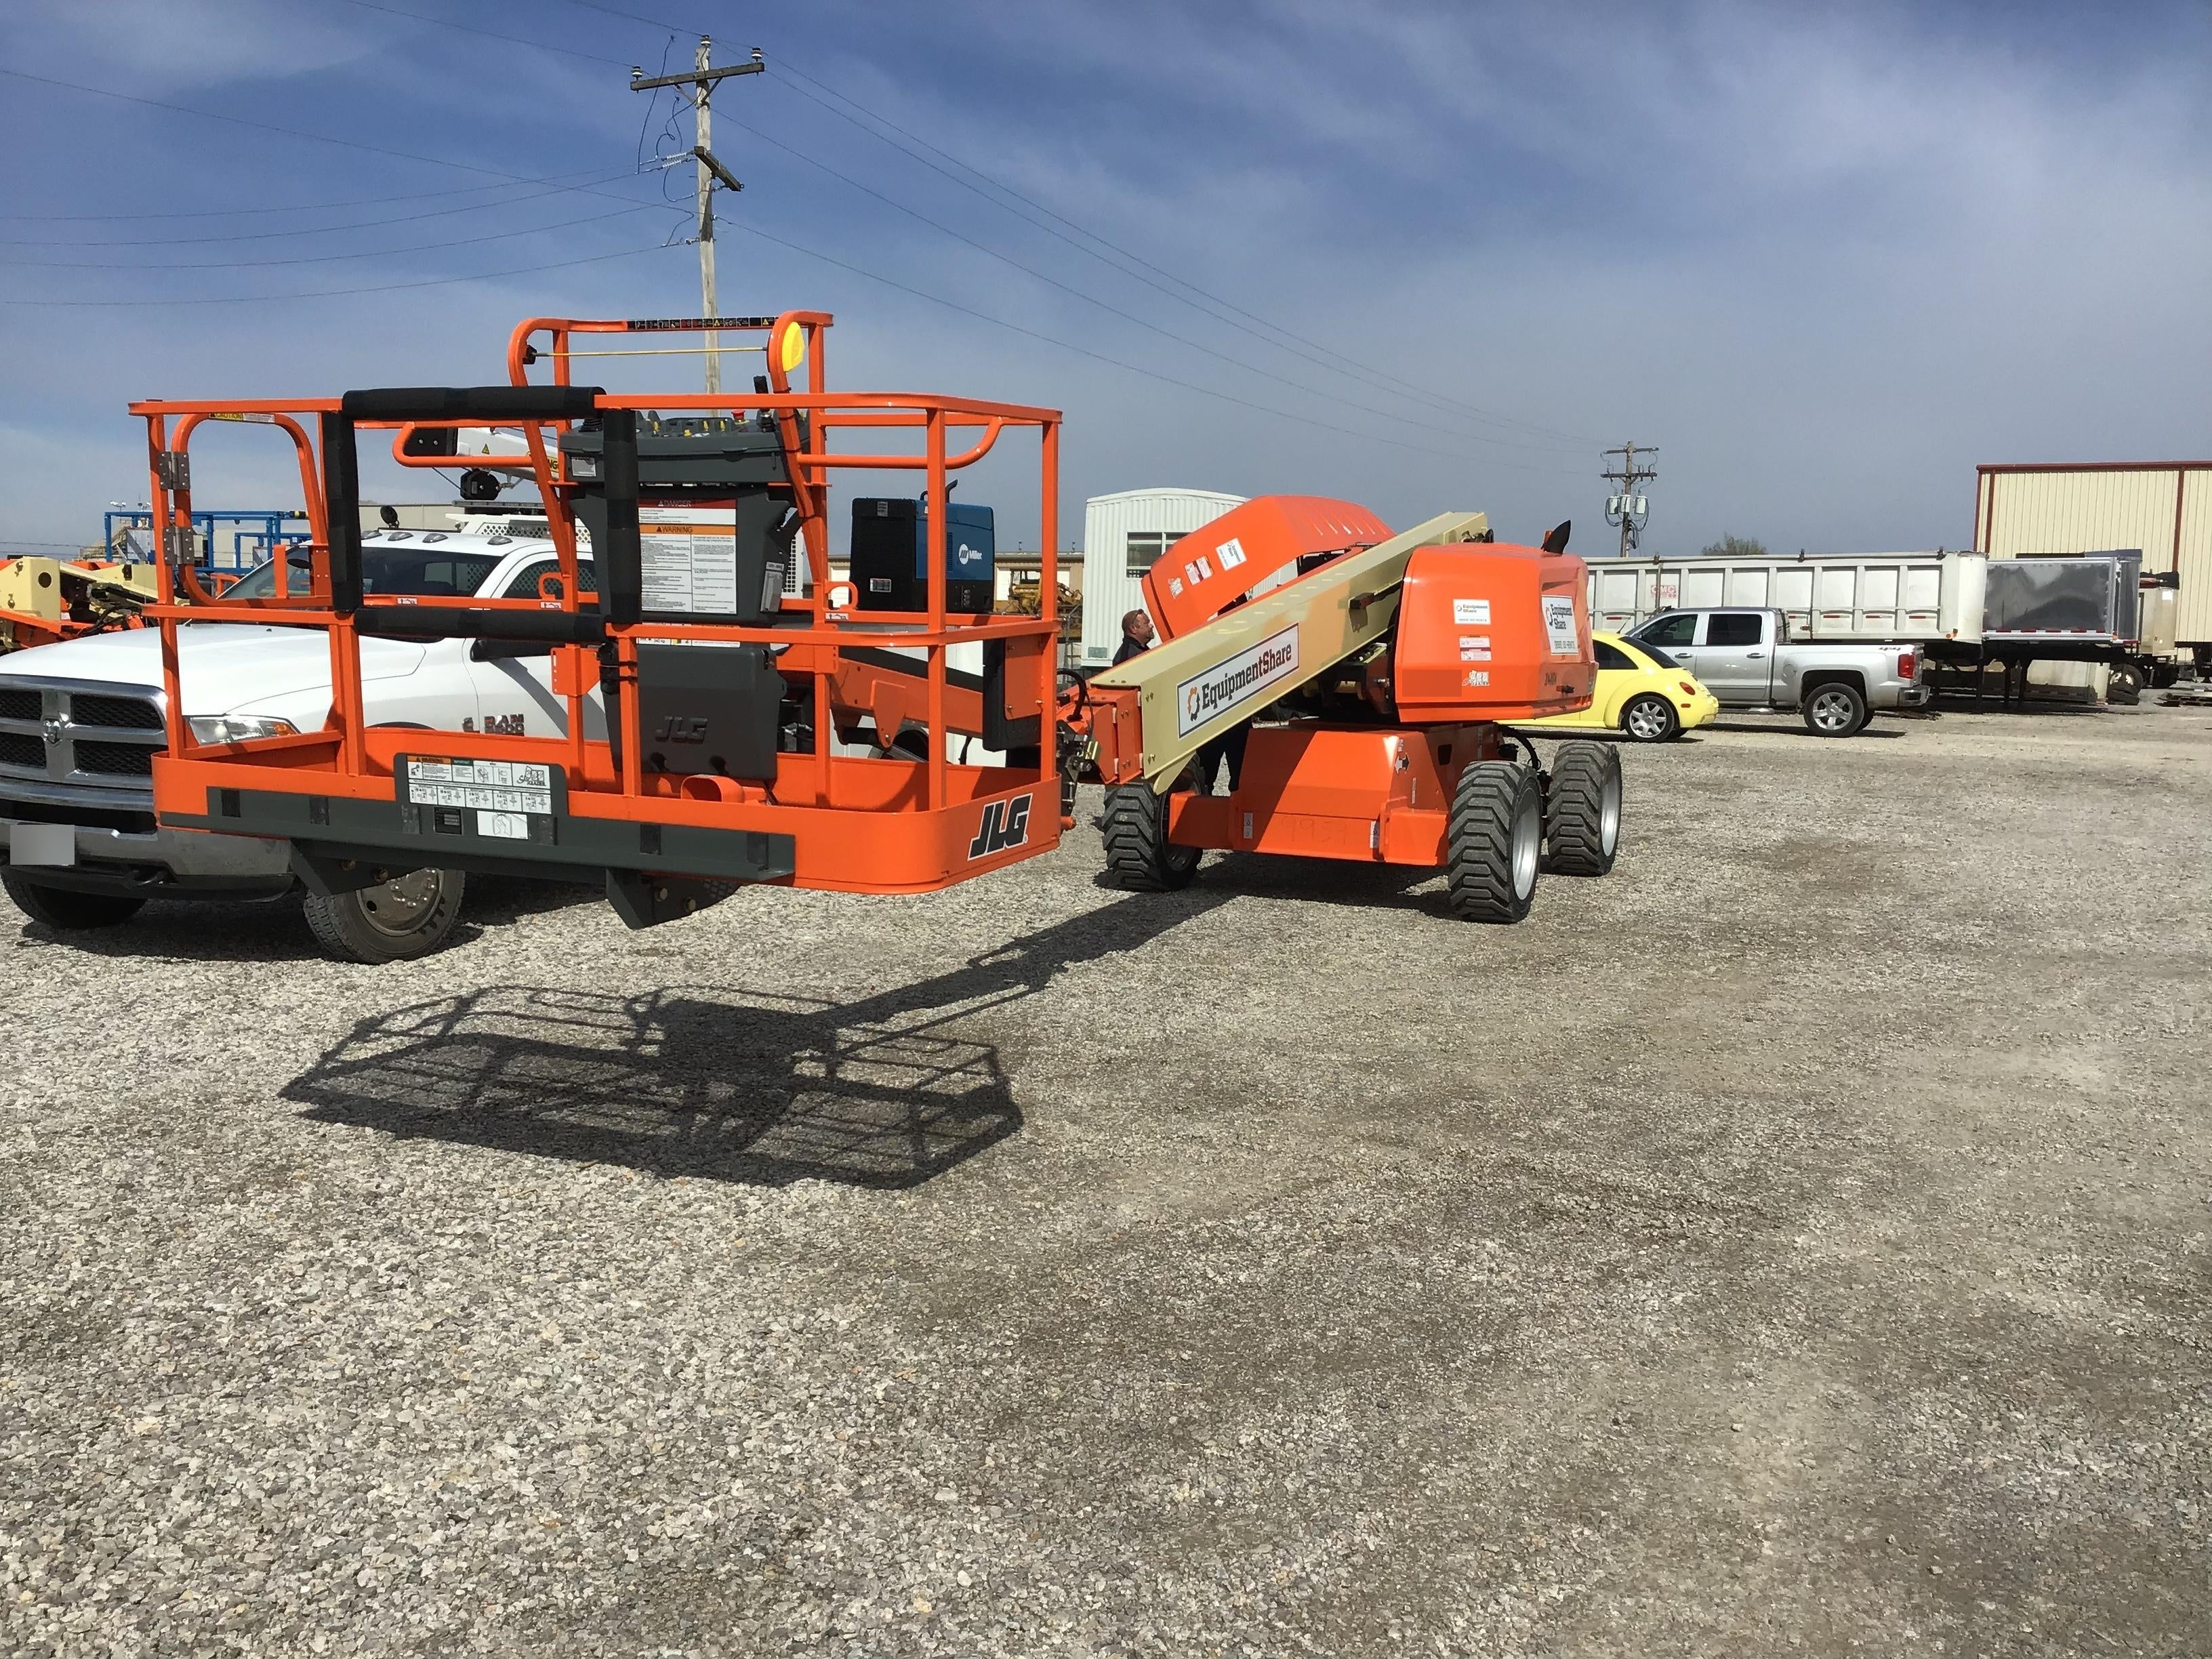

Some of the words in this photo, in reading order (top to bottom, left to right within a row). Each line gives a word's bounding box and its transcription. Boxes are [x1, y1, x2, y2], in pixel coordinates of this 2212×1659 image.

[969, 550, 982, 560] Miller
[1202, 643, 1292, 710] EquipmentShare
[655, 716, 708, 745] JLG
[967, 792, 1033, 861] JLG
